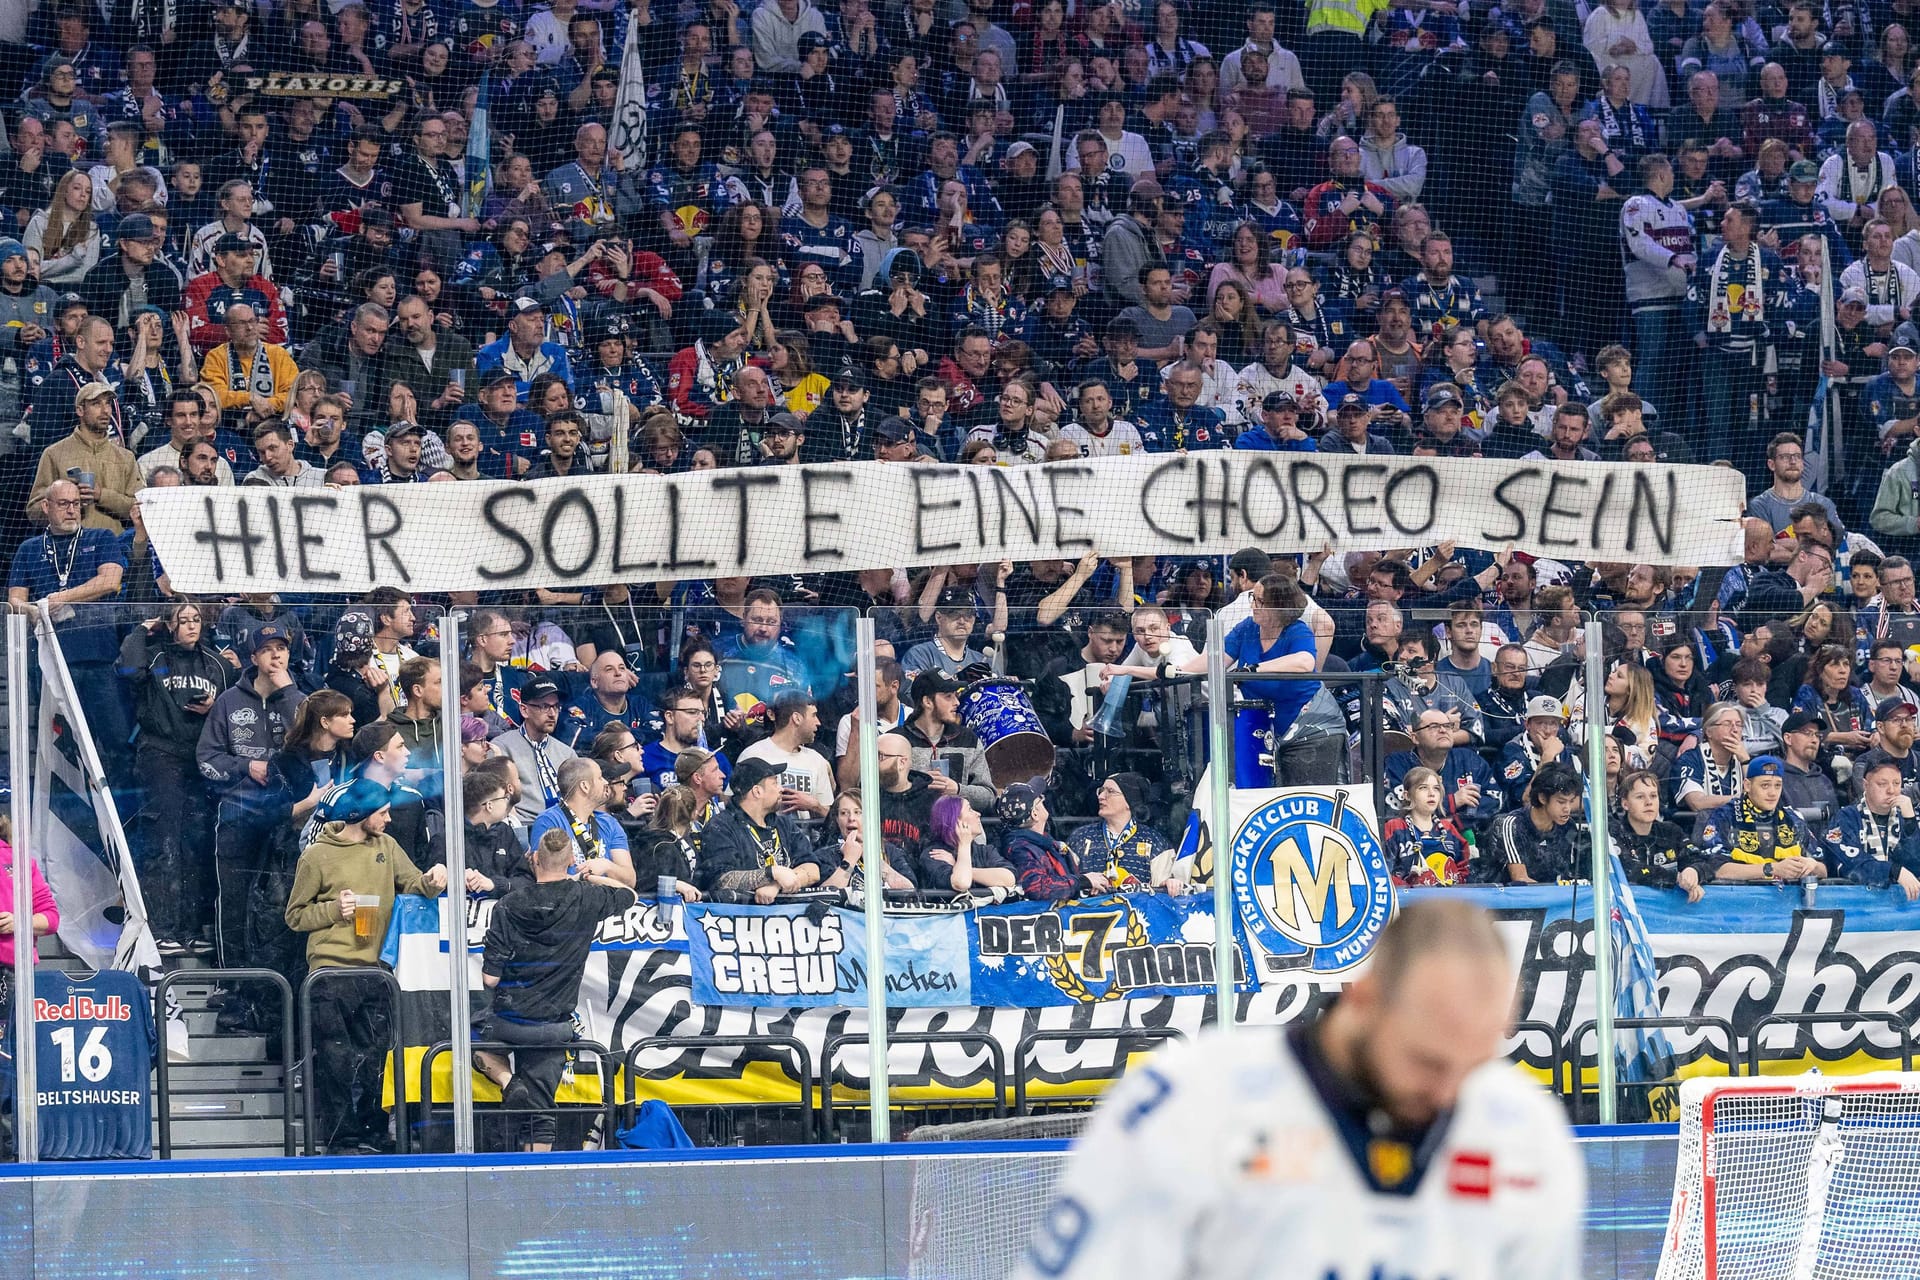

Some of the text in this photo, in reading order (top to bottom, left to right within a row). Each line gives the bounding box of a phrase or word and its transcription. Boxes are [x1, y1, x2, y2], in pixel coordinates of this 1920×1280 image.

[246, 77, 402, 94] PLAYOFFS
[1186, 189, 1202, 202] 25
[195, 456, 1678, 582] HIER SOLLTE EINE CHOREO SEIN
[1680, 766, 1694, 778] 27
[1233, 800, 1320, 935] EISHOCKEYCLUB
[1268, 836, 1357, 931] M
[705, 913, 845, 956] CHAOS
[978, 912, 1064, 956] DER
[1069, 910, 1123, 982] 7
[710, 952, 838, 996] CREW
[838, 957, 958, 993] Mnchen
[34, 995, 131, 1022] Red Bulls
[50, 1026, 113, 1083] 16
[37, 1090, 140, 1106] BELTSHAUSER
[1705, 1131, 1717, 1178] PENNY
